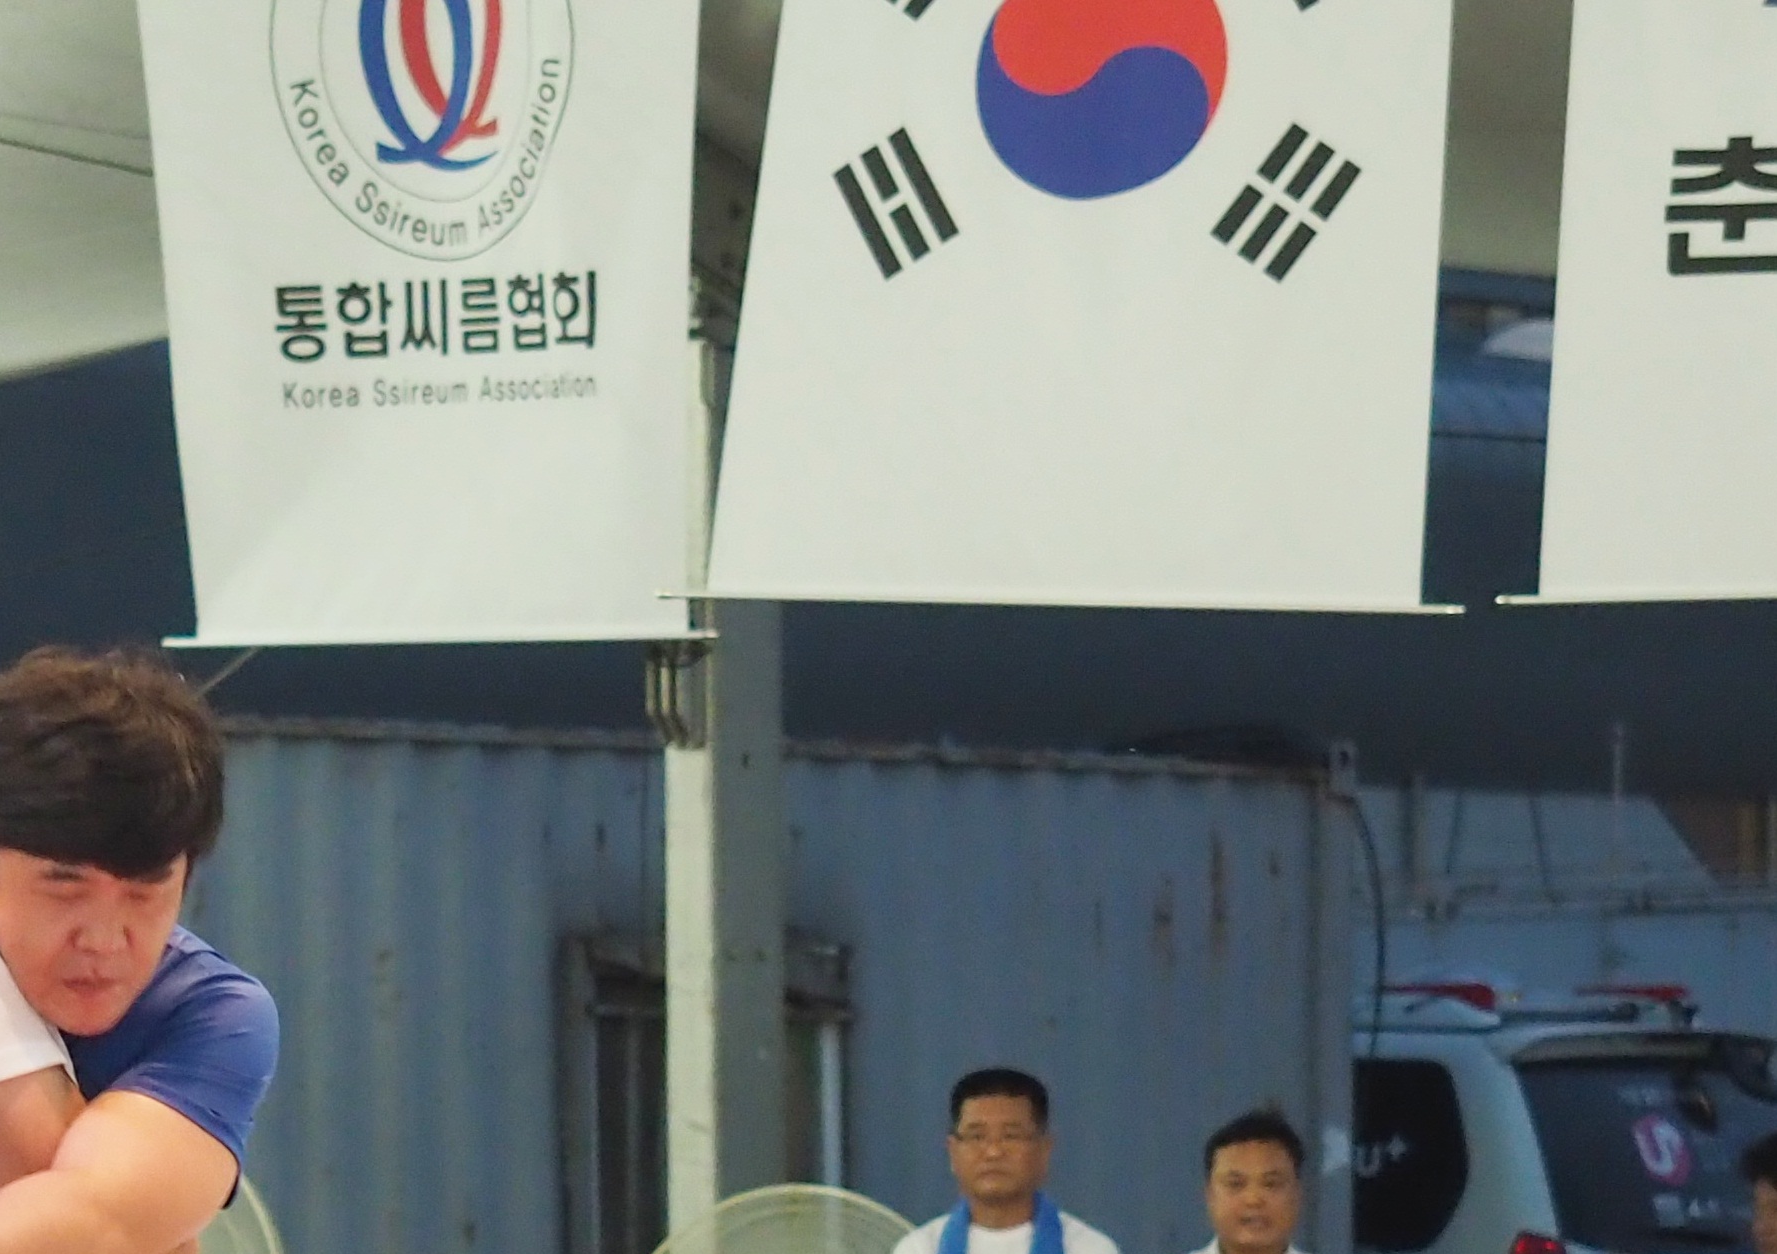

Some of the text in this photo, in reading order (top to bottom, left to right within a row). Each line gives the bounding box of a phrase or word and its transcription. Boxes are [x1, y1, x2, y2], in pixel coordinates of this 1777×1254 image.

[289, 56, 562, 249] Korea Ssireum Association
[1665, 136, 1777, 277] 춘
[274, 270, 598, 363] 통합씨름협회
[282, 374, 598, 409] Korea Ssireum Association
